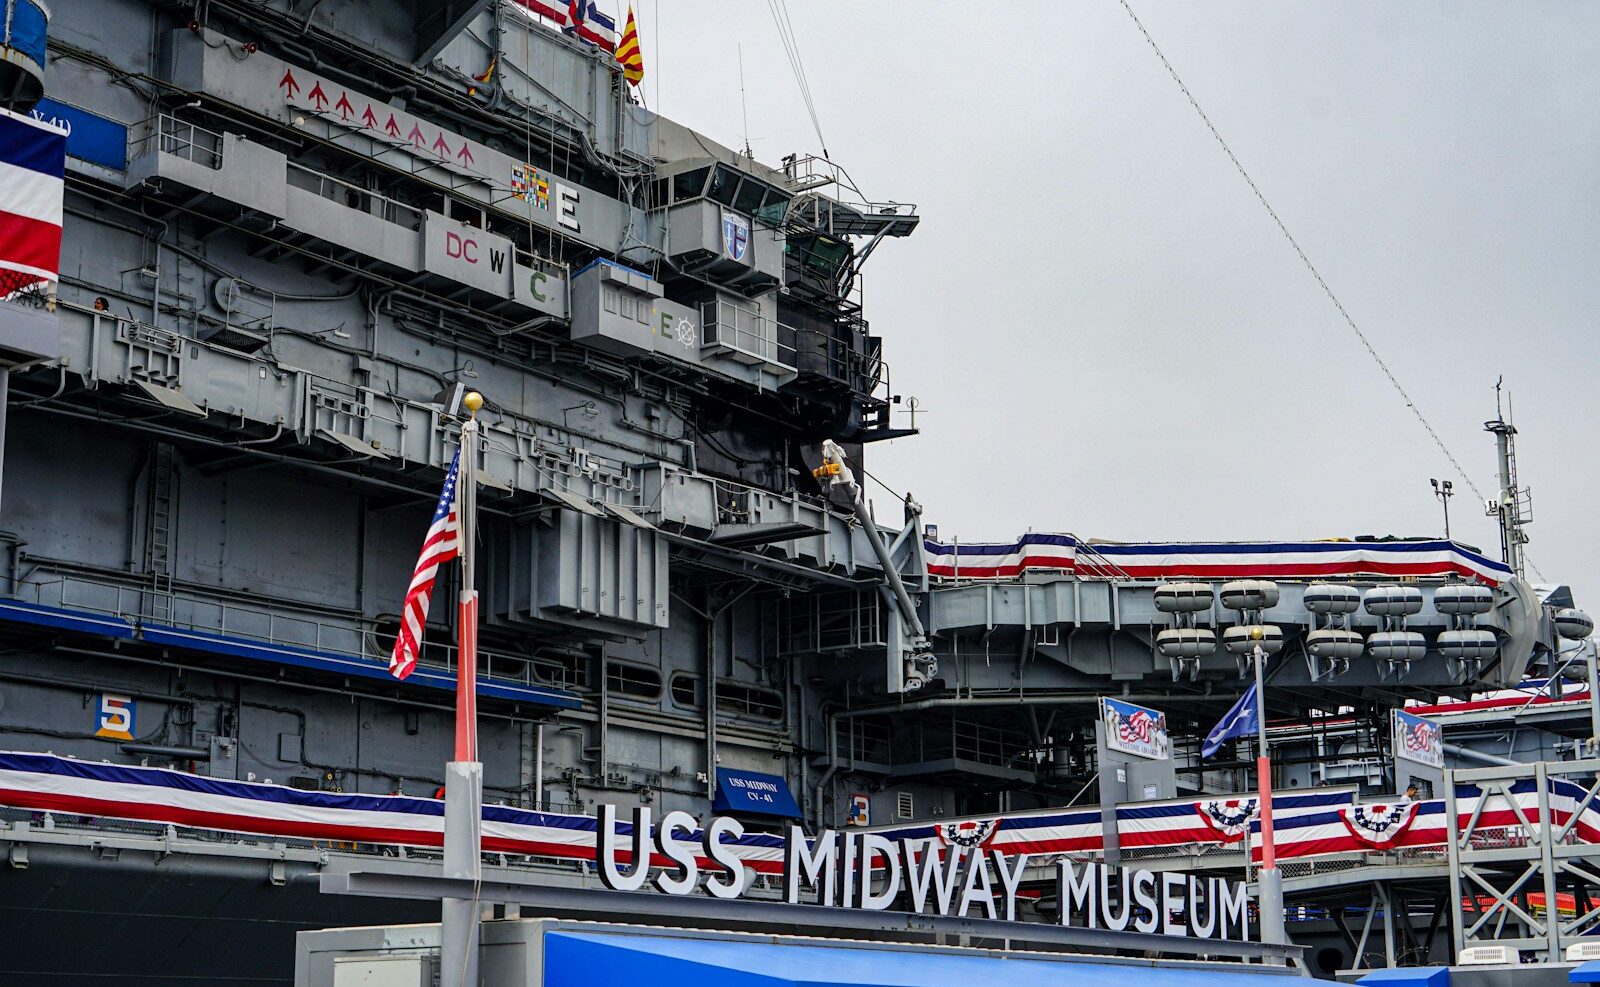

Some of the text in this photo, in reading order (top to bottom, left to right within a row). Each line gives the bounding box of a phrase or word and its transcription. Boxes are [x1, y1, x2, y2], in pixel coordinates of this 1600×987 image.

[556, 182, 581, 234] E
[446, 231, 505, 274] DC W
[530, 271, 547, 302] C
[661, 312, 673, 340] E
[101, 693, 131, 732] 5
[1118, 740, 1140, 752] WELCOME
[728, 777, 778, 793] USS MIDWAY
[598, 804, 1249, 941] USS MIDWAY MUSEUM
